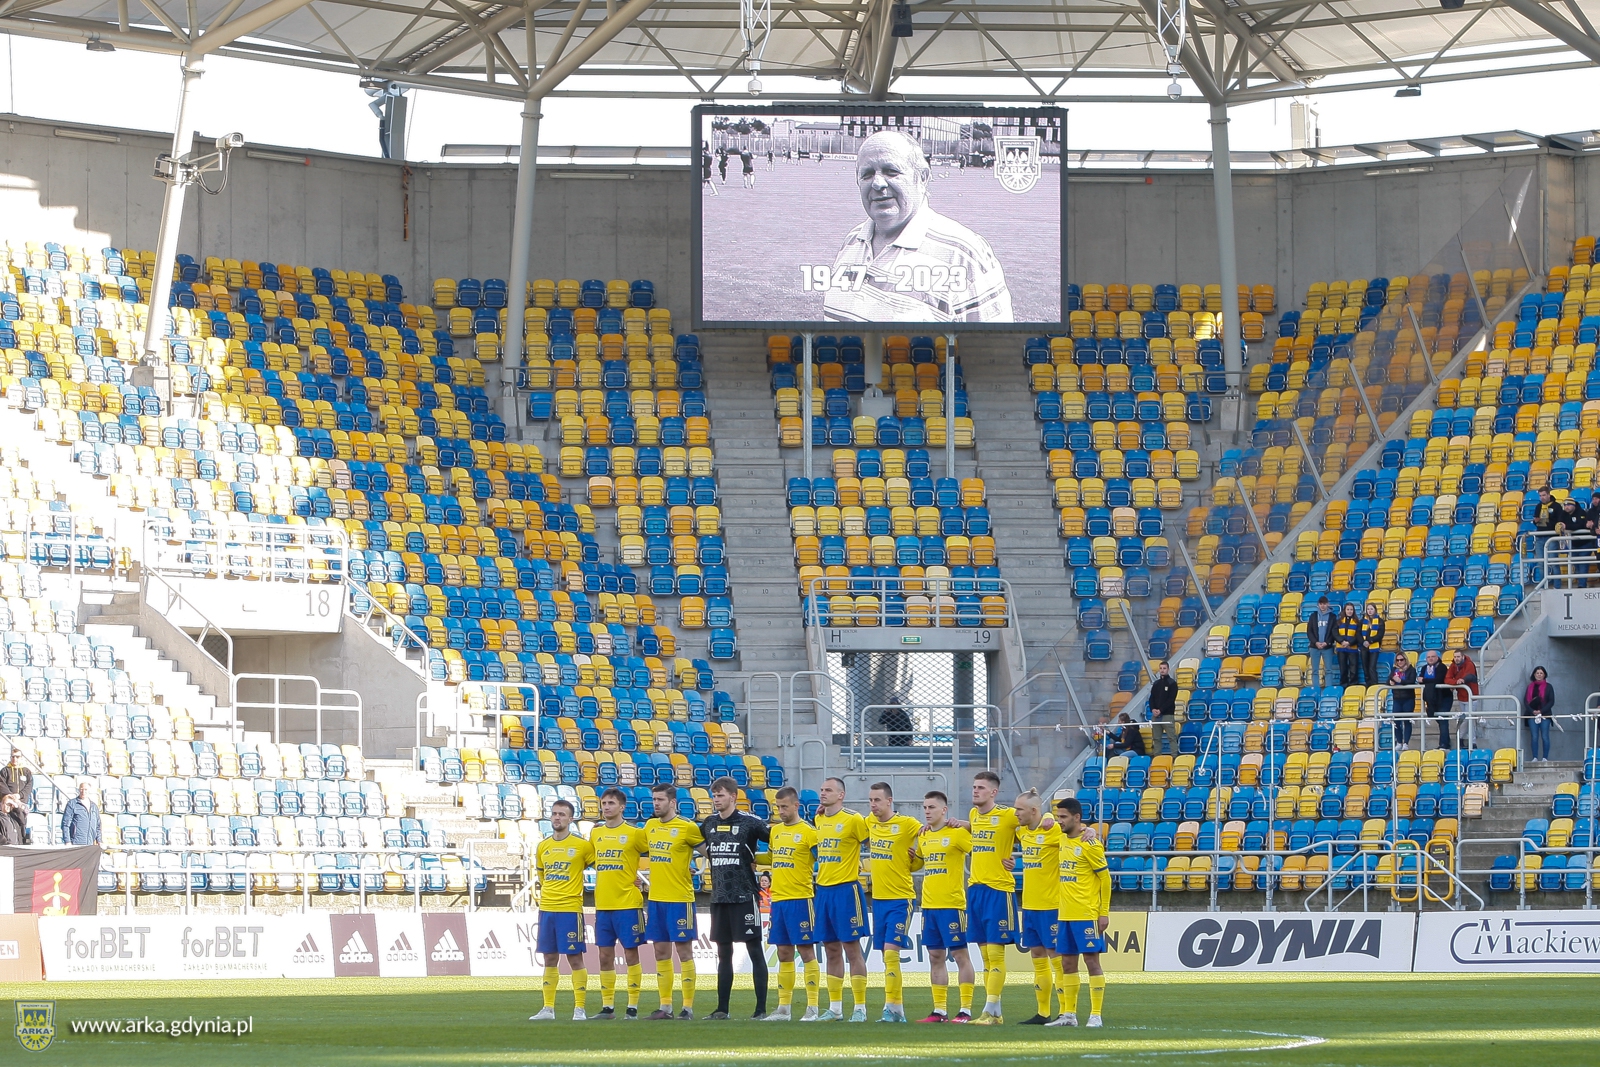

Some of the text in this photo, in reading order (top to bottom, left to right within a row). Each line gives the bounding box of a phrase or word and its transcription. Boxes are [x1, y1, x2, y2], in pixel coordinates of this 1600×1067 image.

[1003, 166, 1033, 174] ARKA
[800, 265, 867, 292] 1947
[895, 265, 968, 292] 2023
[1584, 592, 1600, 600] SEKT
[305, 590, 330, 617] 18
[1564, 593, 1573, 620] I
[831, 629, 841, 643] H
[974, 630, 991, 644] 19
[648, 841, 673, 851] forBET
[710, 842, 740, 852] forBET
[596, 849, 624, 858] forBET
[650, 855, 672, 863] GDYNIA
[544, 861, 572, 871] forBET
[596, 863, 624, 871] GDYNIA
[712, 857, 740, 867] GDYNIA
[545, 873, 570, 881] GDYNIA
[181, 926, 264, 958] forBET
[1471, 918, 1600, 955] Mackiew
[65, 927, 151, 959] forBET
[1177, 918, 1382, 968] GDYNIA
[292, 953, 325, 964] adidas
[339, 952, 374, 964] adidas
[386, 951, 418, 962] adidas
[431, 950, 465, 962] adidas
[477, 949, 507, 960] adidas
